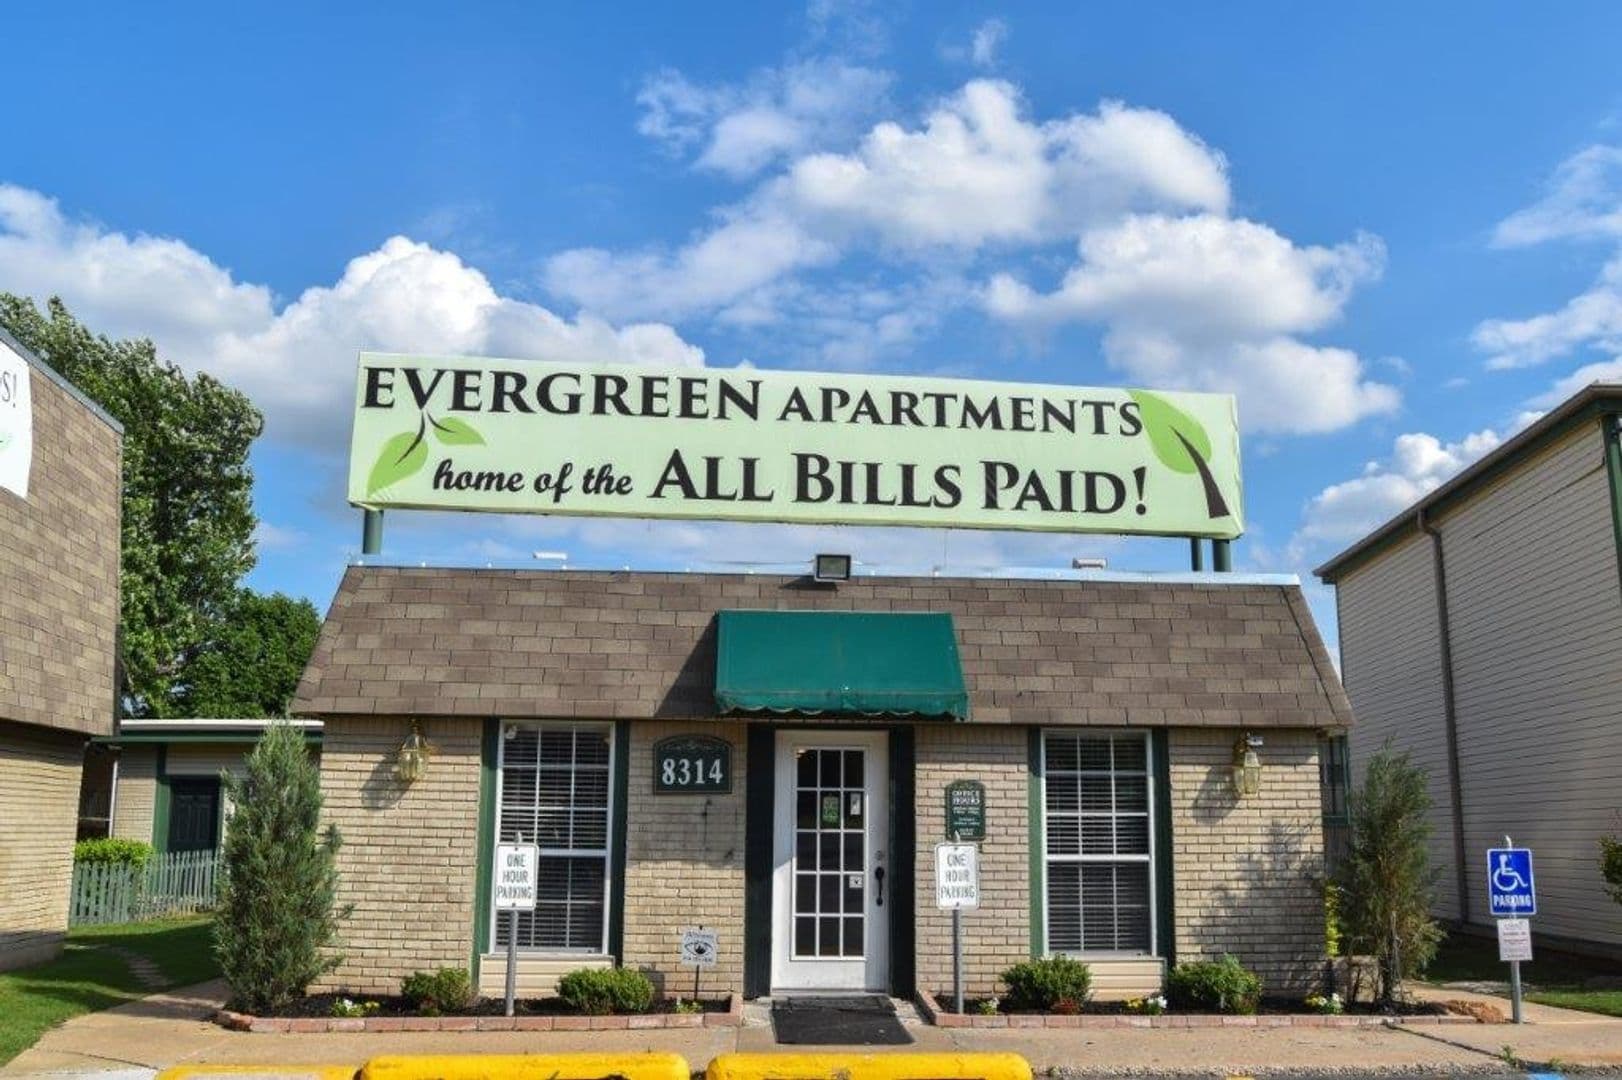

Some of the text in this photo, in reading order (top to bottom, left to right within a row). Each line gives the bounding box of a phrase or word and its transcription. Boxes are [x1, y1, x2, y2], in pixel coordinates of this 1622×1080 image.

[361, 366, 1144, 437] EVERGREEN APARTMENTS
[432, 448, 1149, 517] home of the ALL BILLS PAID!
[661, 758, 723, 785] 8314
[506, 854, 527, 867] ONE
[947, 854, 967, 867] ONE
[502, 870, 528, 883] HOUR
[945, 870, 970, 882] HOUR
[940, 885, 975, 899] PARKING
[1493, 894, 1531, 907] PARKING
